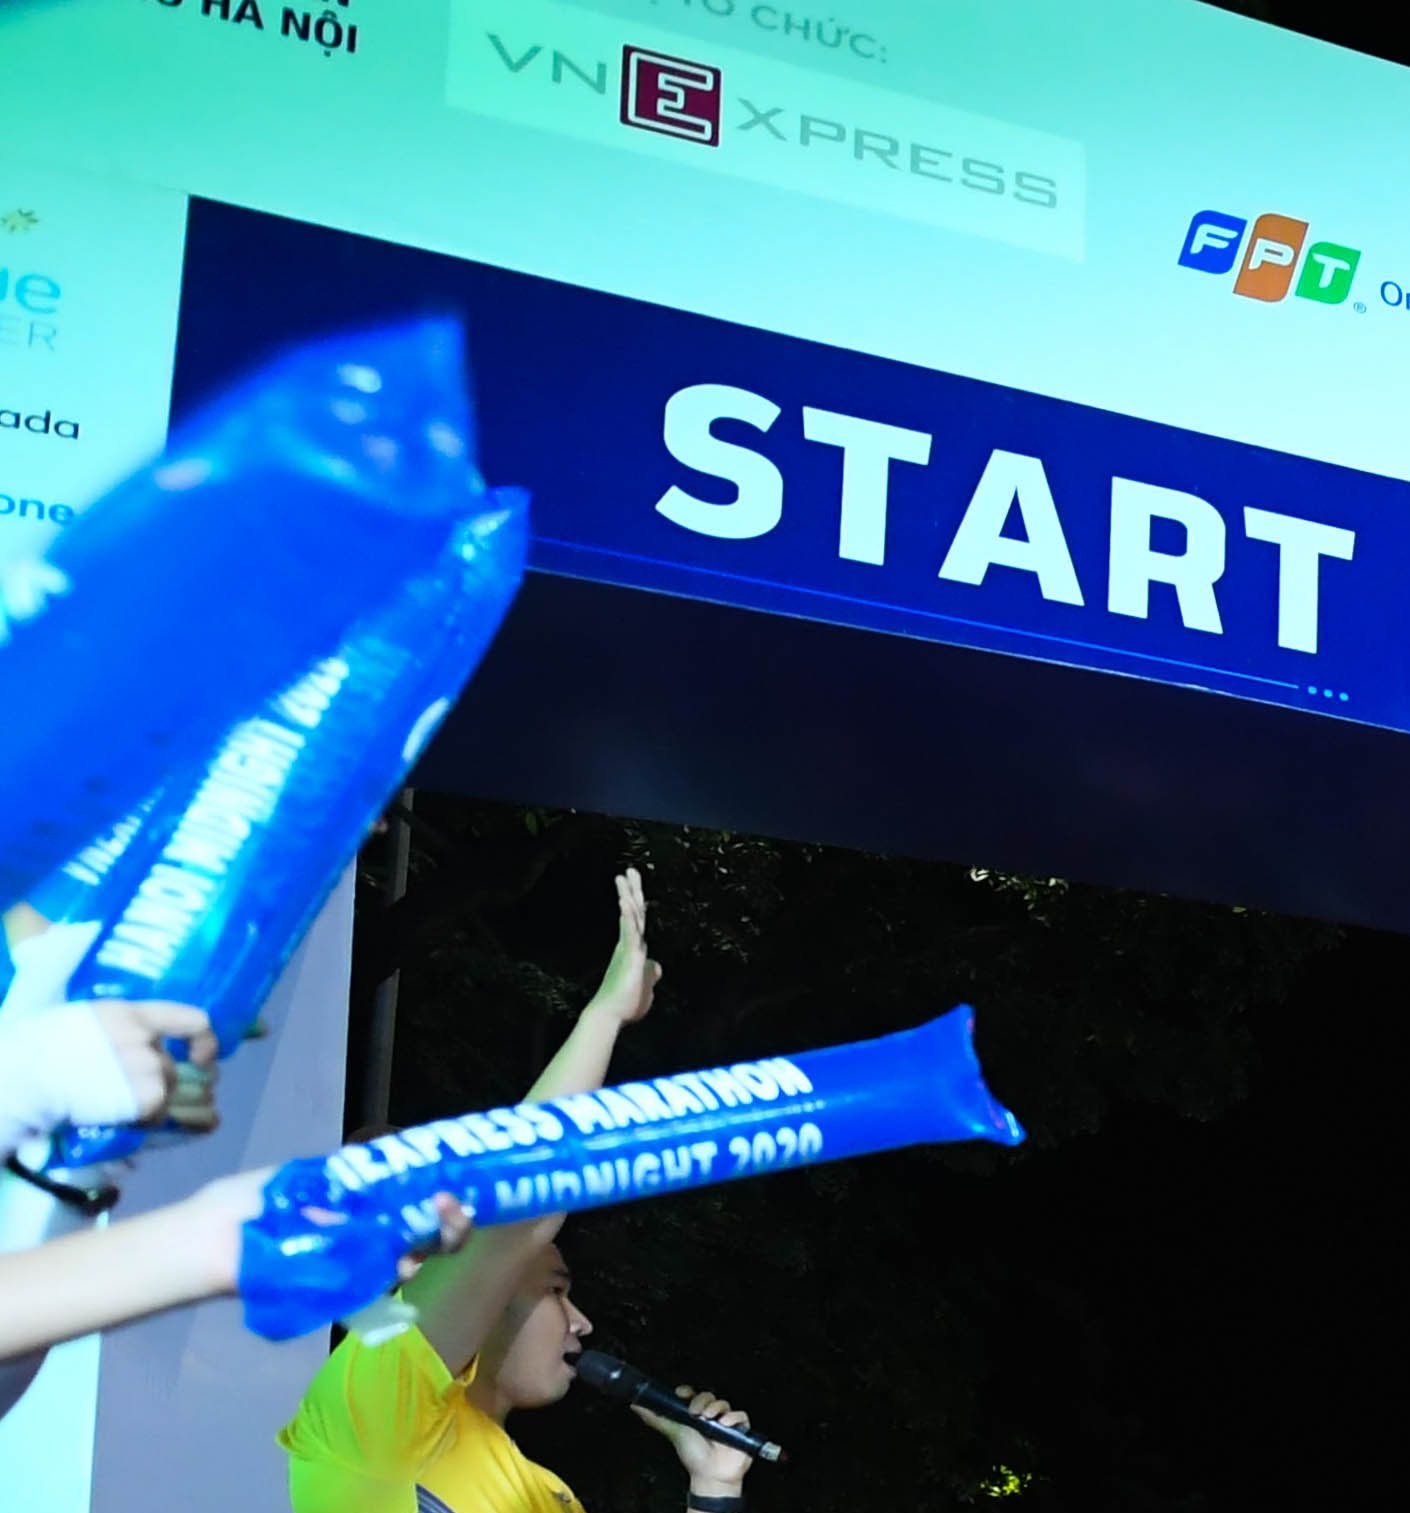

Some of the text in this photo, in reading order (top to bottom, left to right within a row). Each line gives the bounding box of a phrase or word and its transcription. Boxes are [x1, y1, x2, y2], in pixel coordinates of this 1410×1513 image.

[281, 6, 358, 57] NỘI
[750, 3, 888, 63] CHỨC:
[486, 31, 1058, 209] VNEXPRESS
[1180, 214, 1358, 298] FPT
[655, 383, 1355, 655] START
[562, 1057, 814, 1135] MARATHON
